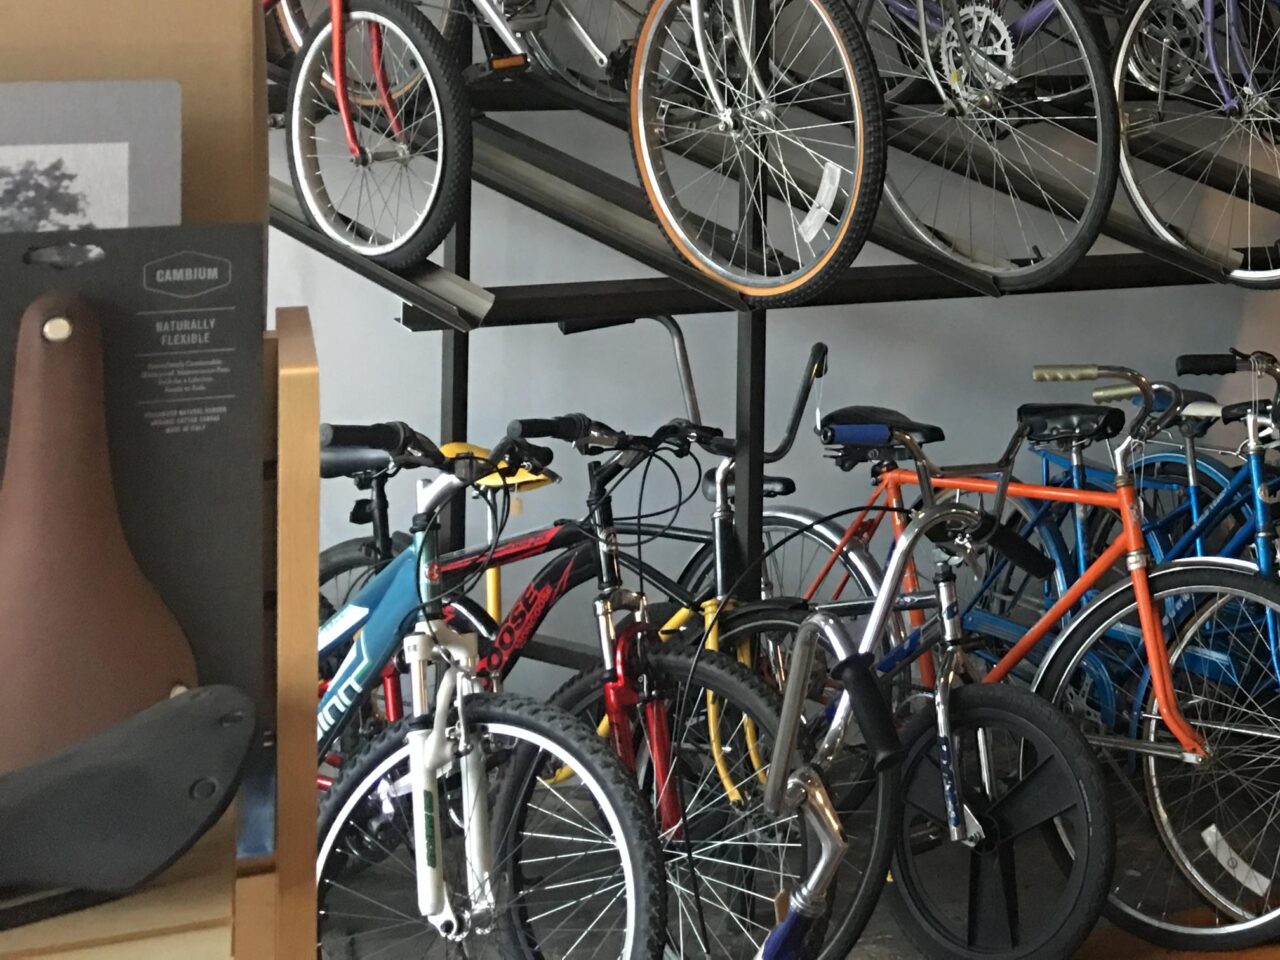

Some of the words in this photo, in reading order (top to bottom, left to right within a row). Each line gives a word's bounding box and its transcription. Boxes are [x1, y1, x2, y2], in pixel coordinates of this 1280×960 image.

[156, 266, 219, 282] CAMBIUM
[155, 318, 216, 332] NATURALLY
[161, 332, 211, 346] FLEXIBLE
